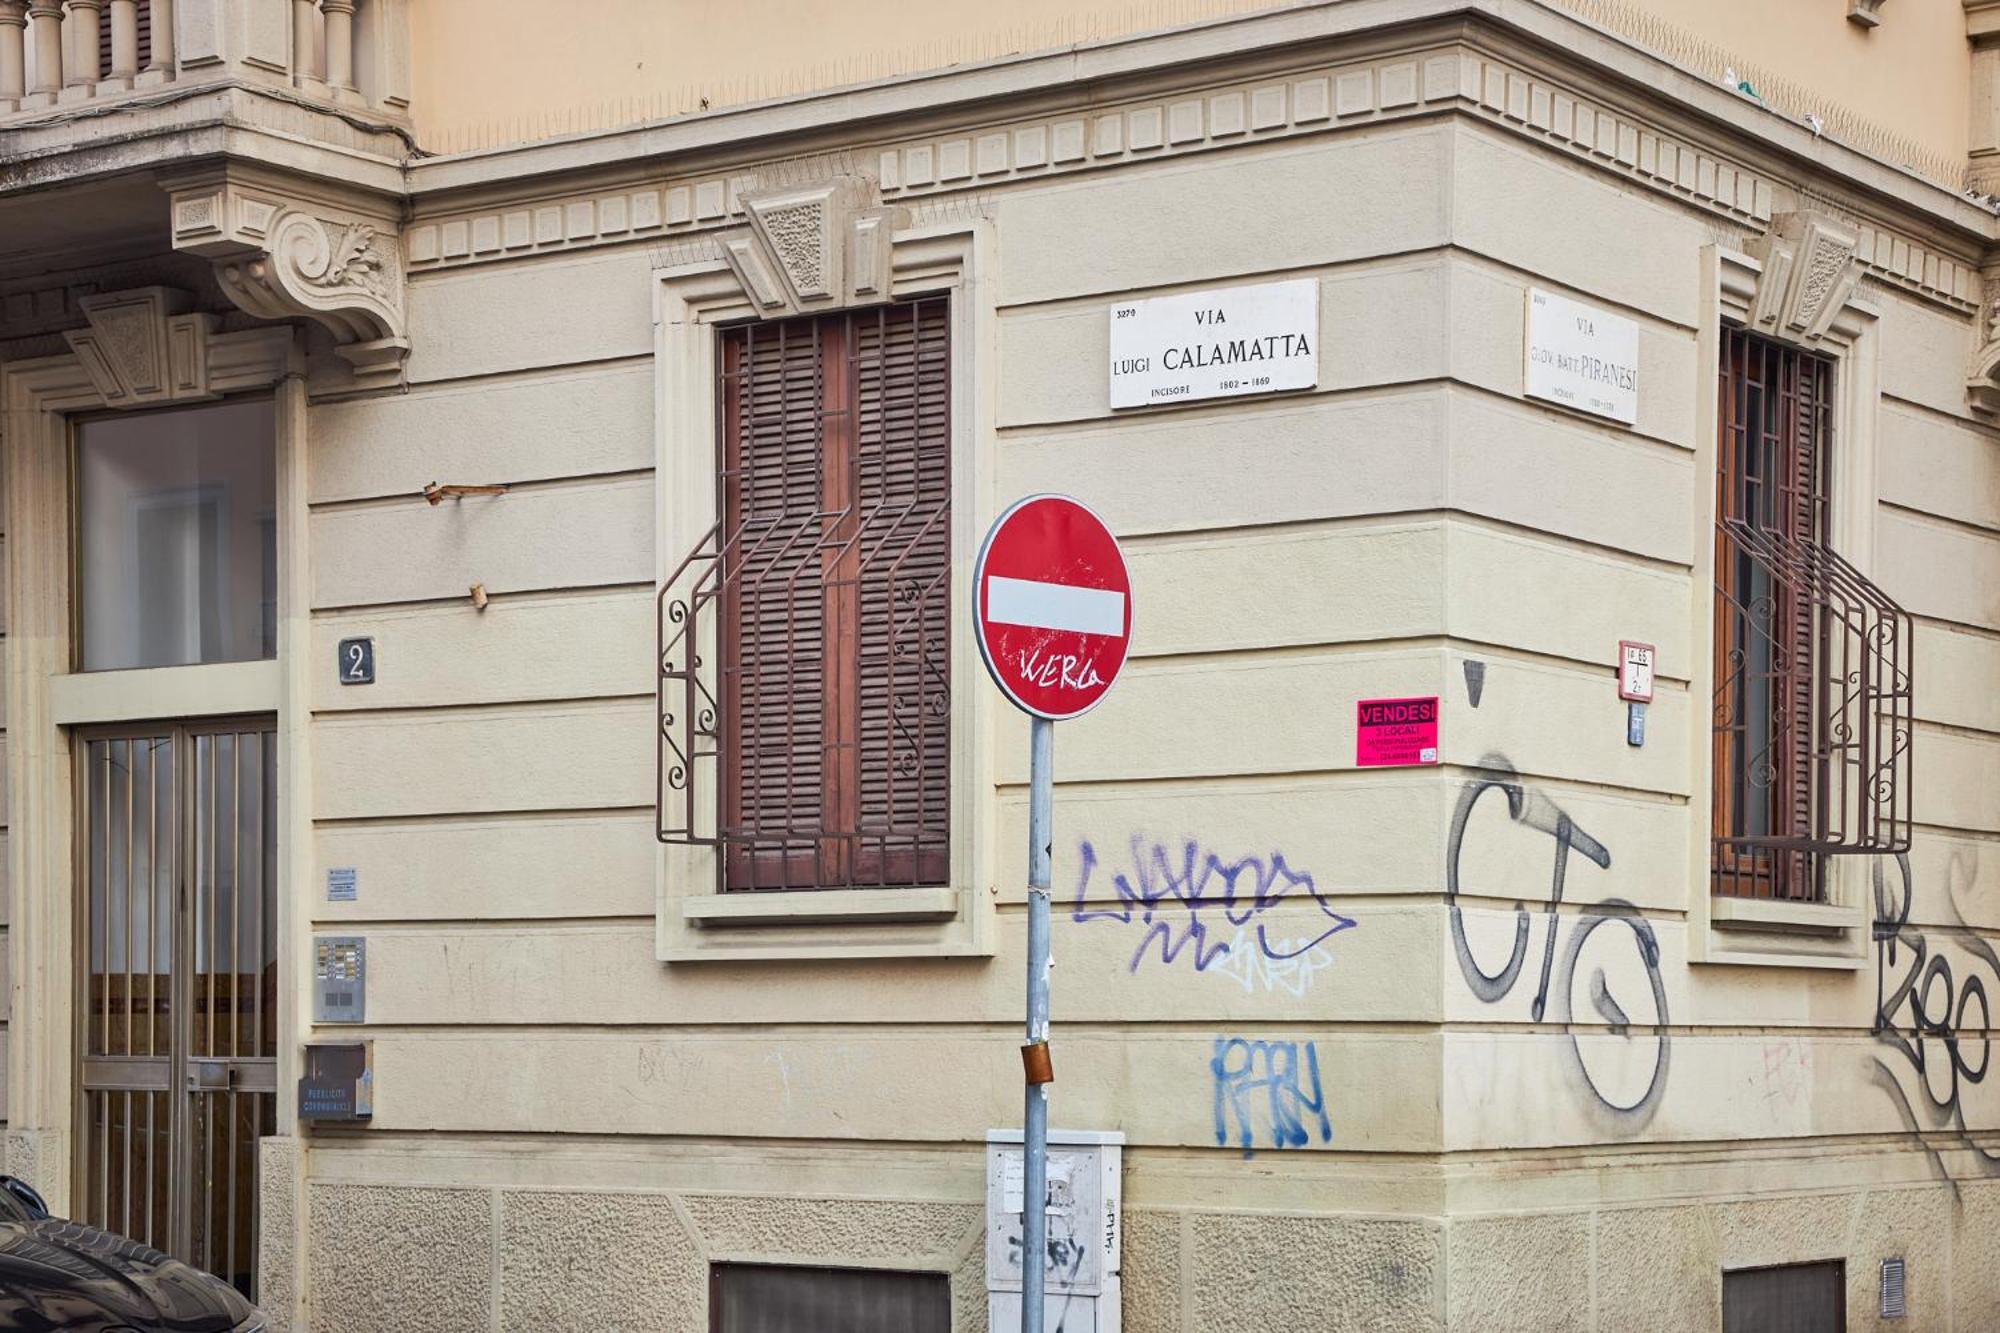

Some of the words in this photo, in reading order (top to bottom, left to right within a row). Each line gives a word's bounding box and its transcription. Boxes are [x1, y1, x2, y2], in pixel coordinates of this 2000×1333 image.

[1195, 309, 1226, 325] VIA
[1577, 317, 1594, 336] VIA
[1114, 358, 1150, 375] LUIGI
[1163, 333, 1311, 370] CALAMATTA
[1581, 355, 1637, 393] PIRANESI
[1151, 385, 1190, 398] INCISORE
[1220, 380, 1239, 390] 1802
[350, 644, 363, 677] 2
[1361, 703, 1434, 723] VENDESI
